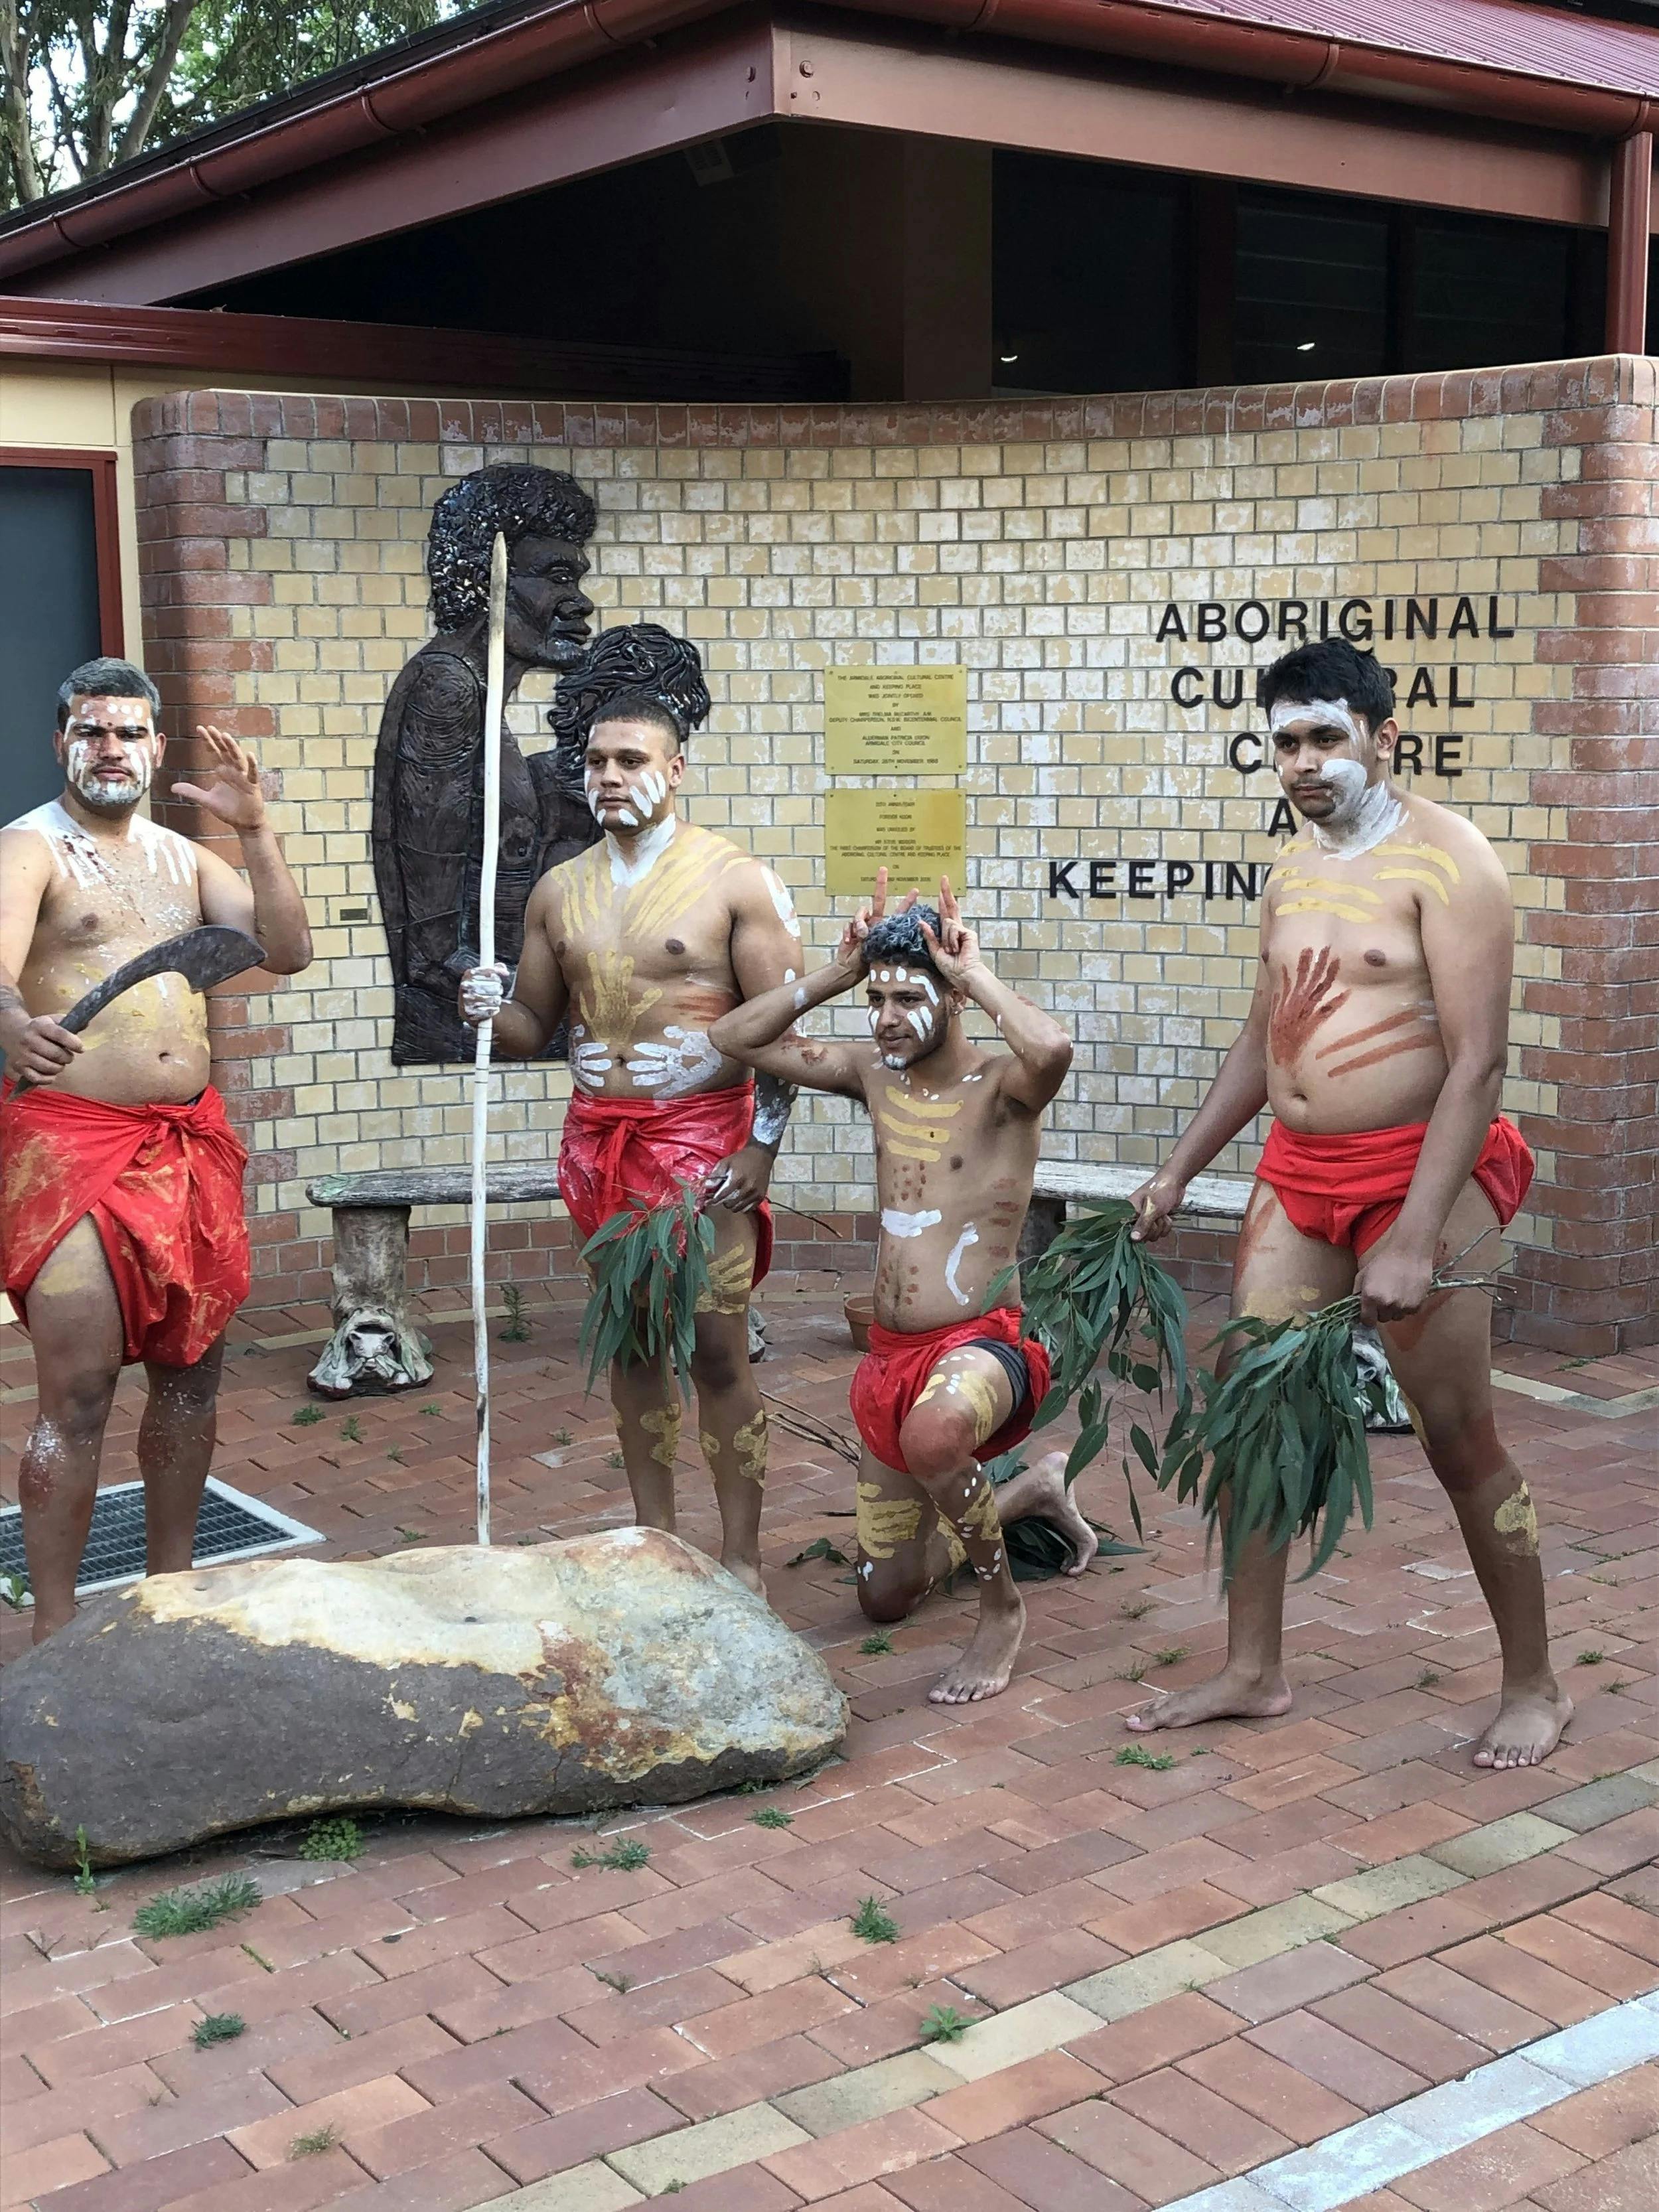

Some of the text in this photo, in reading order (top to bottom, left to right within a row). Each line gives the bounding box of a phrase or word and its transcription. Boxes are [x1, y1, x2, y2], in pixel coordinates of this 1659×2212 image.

[1155, 595, 1514, 644] ABORIGINAL
[1171, 665, 1475, 710] CUAL
[1229, 732, 1463, 777] CRE
[1049, 861, 1273, 902] KEEPIN
